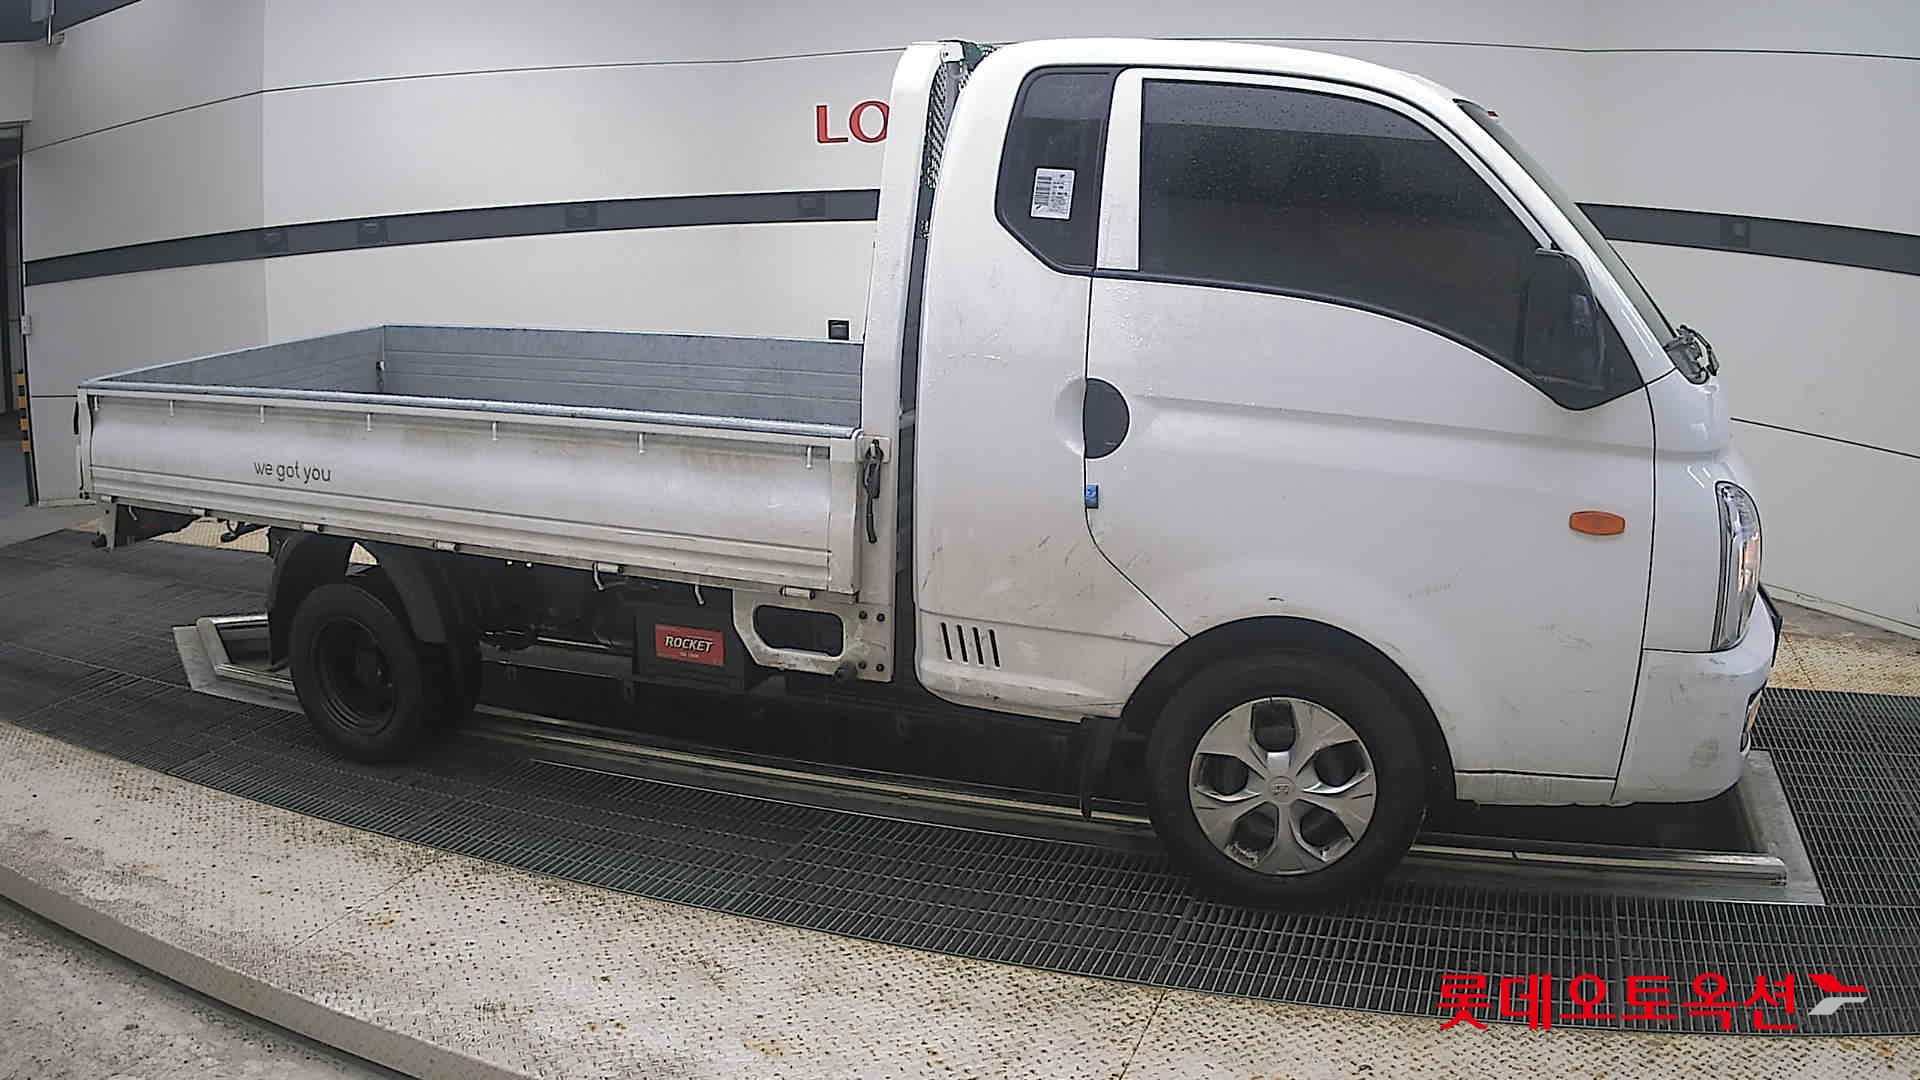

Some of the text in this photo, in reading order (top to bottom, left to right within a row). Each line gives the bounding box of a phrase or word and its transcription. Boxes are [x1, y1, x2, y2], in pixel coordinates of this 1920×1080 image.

[815, 100, 890, 144] LO
[253, 460, 332, 485] we got you
[664, 635, 713, 653] ROCKET
